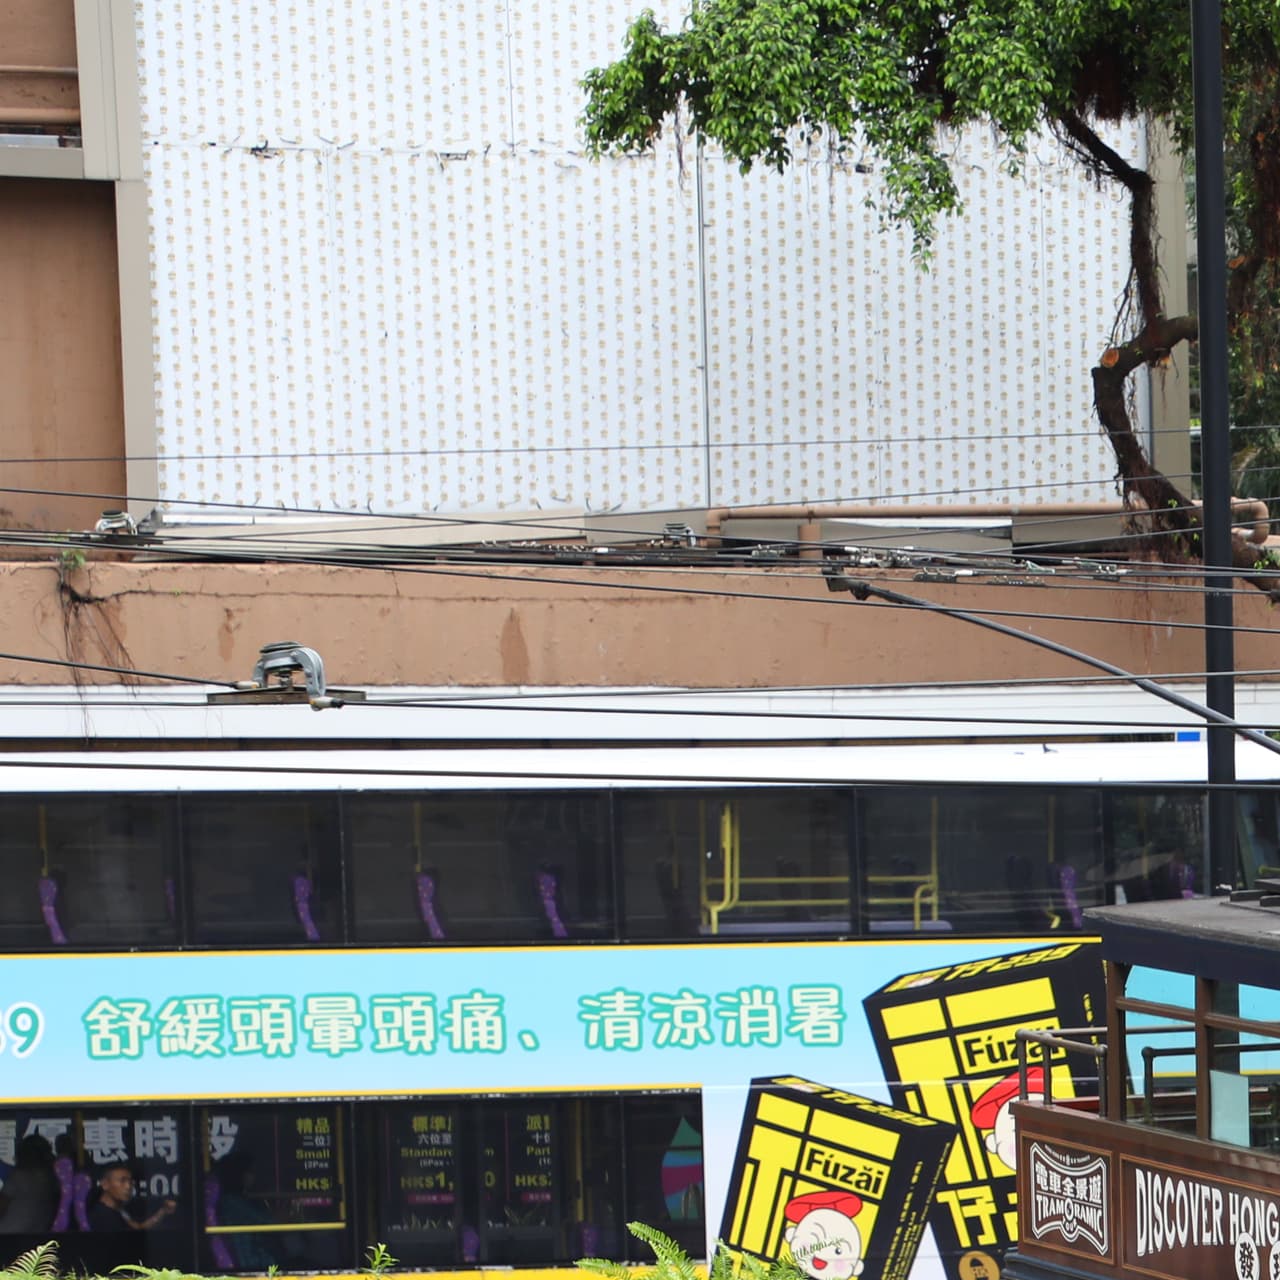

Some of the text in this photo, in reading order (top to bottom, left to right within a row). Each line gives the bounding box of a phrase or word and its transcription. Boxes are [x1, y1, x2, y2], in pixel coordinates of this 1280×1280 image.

[0, 1000, 45, 1059] 9
[1035, 1160, 1102, 1204] 電車全景遊
[1036, 1194, 1103, 1239] TRAMORAMIC
[1135, 1168, 1224, 1257] DISCOVER
